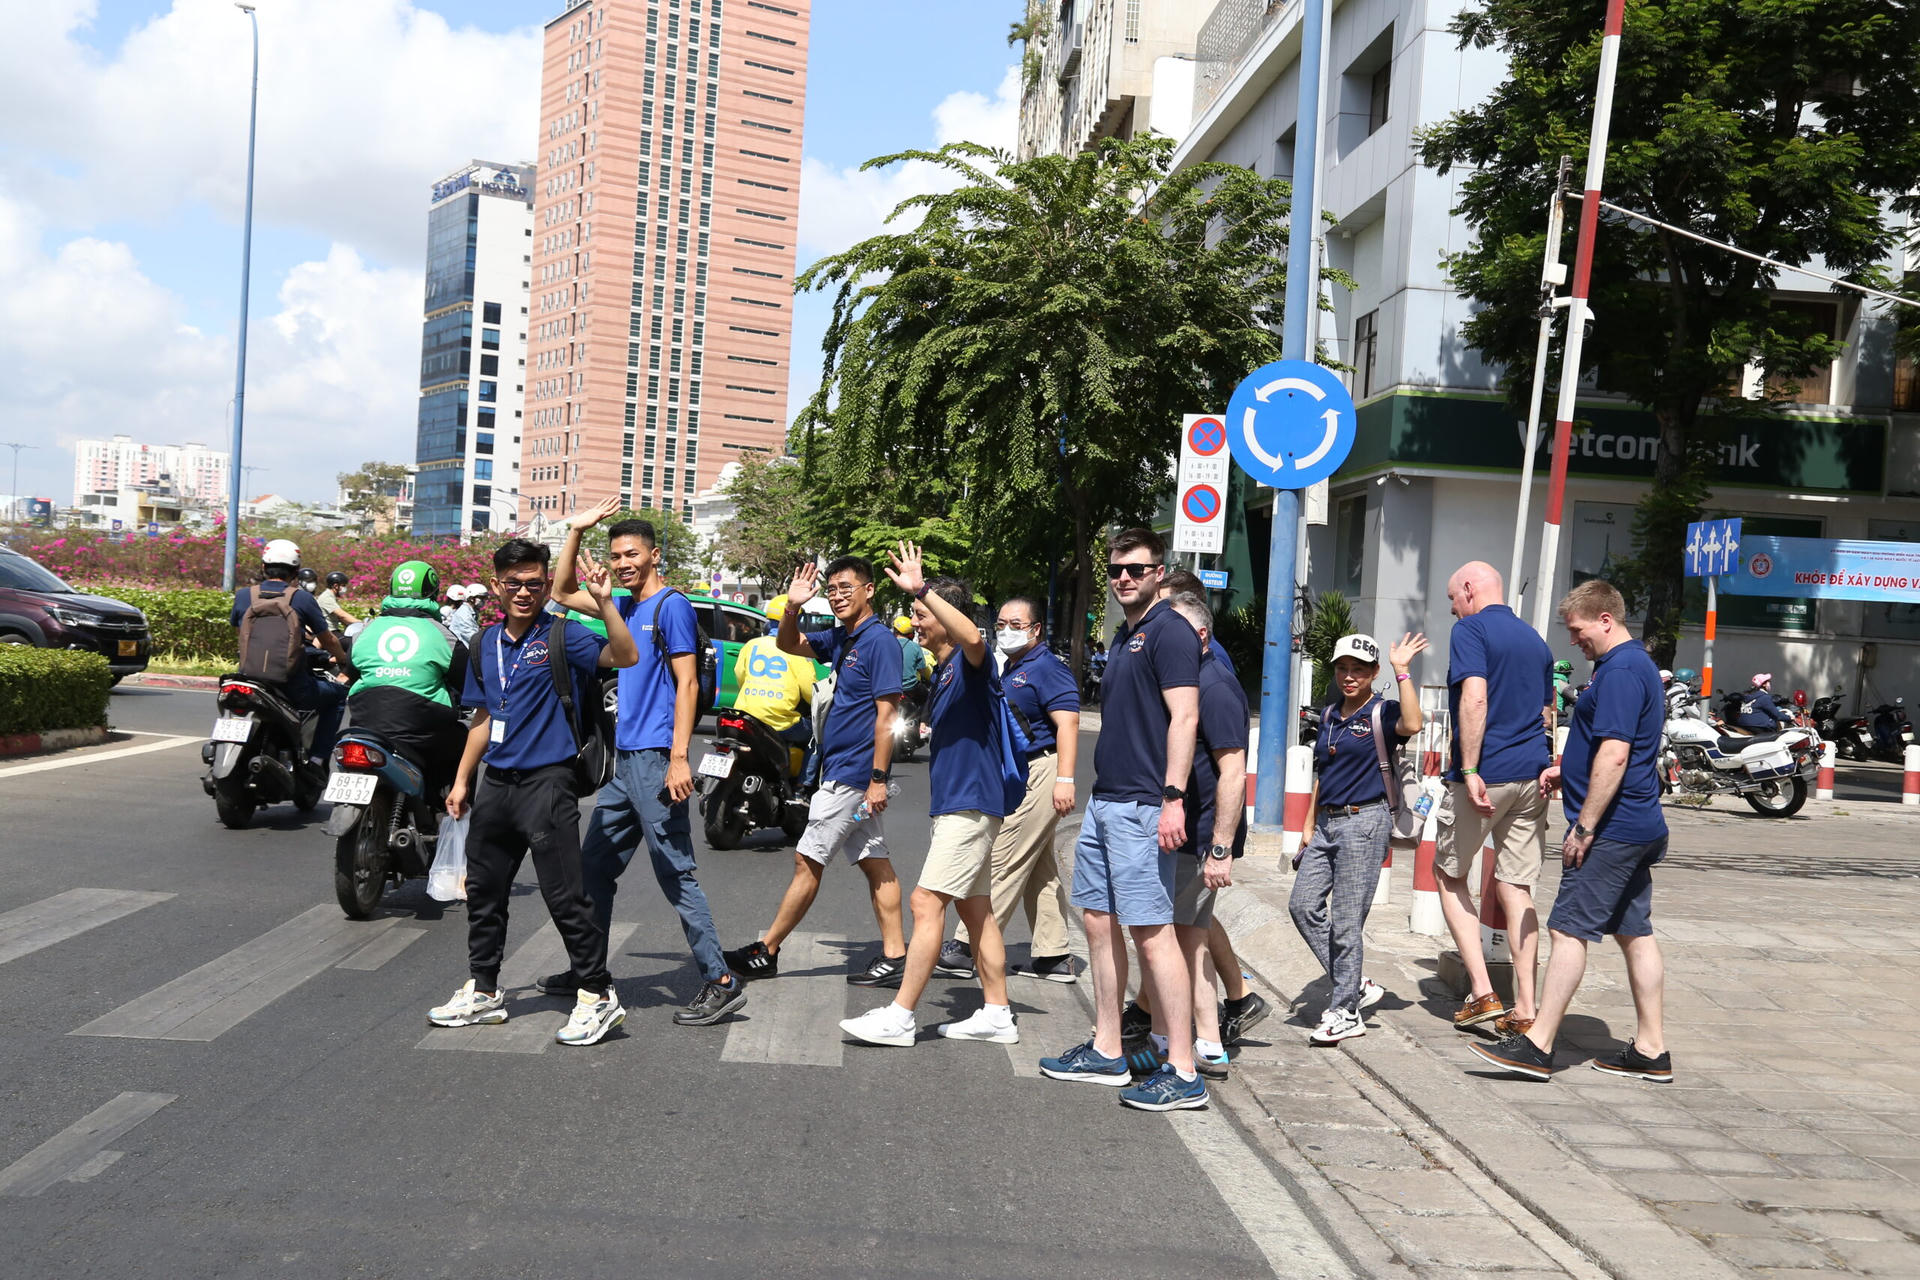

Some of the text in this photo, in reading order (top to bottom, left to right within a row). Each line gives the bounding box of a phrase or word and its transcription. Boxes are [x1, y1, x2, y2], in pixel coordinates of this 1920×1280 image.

[1795, 568, 1920, 590] KHỎE ĐỂ XÂY DỰNG V
[749, 645, 788, 680] be
[375, 666, 412, 678] gojek
[336, 775, 369, 789] 69-F1
[327, 786, 370, 802] 709.32
